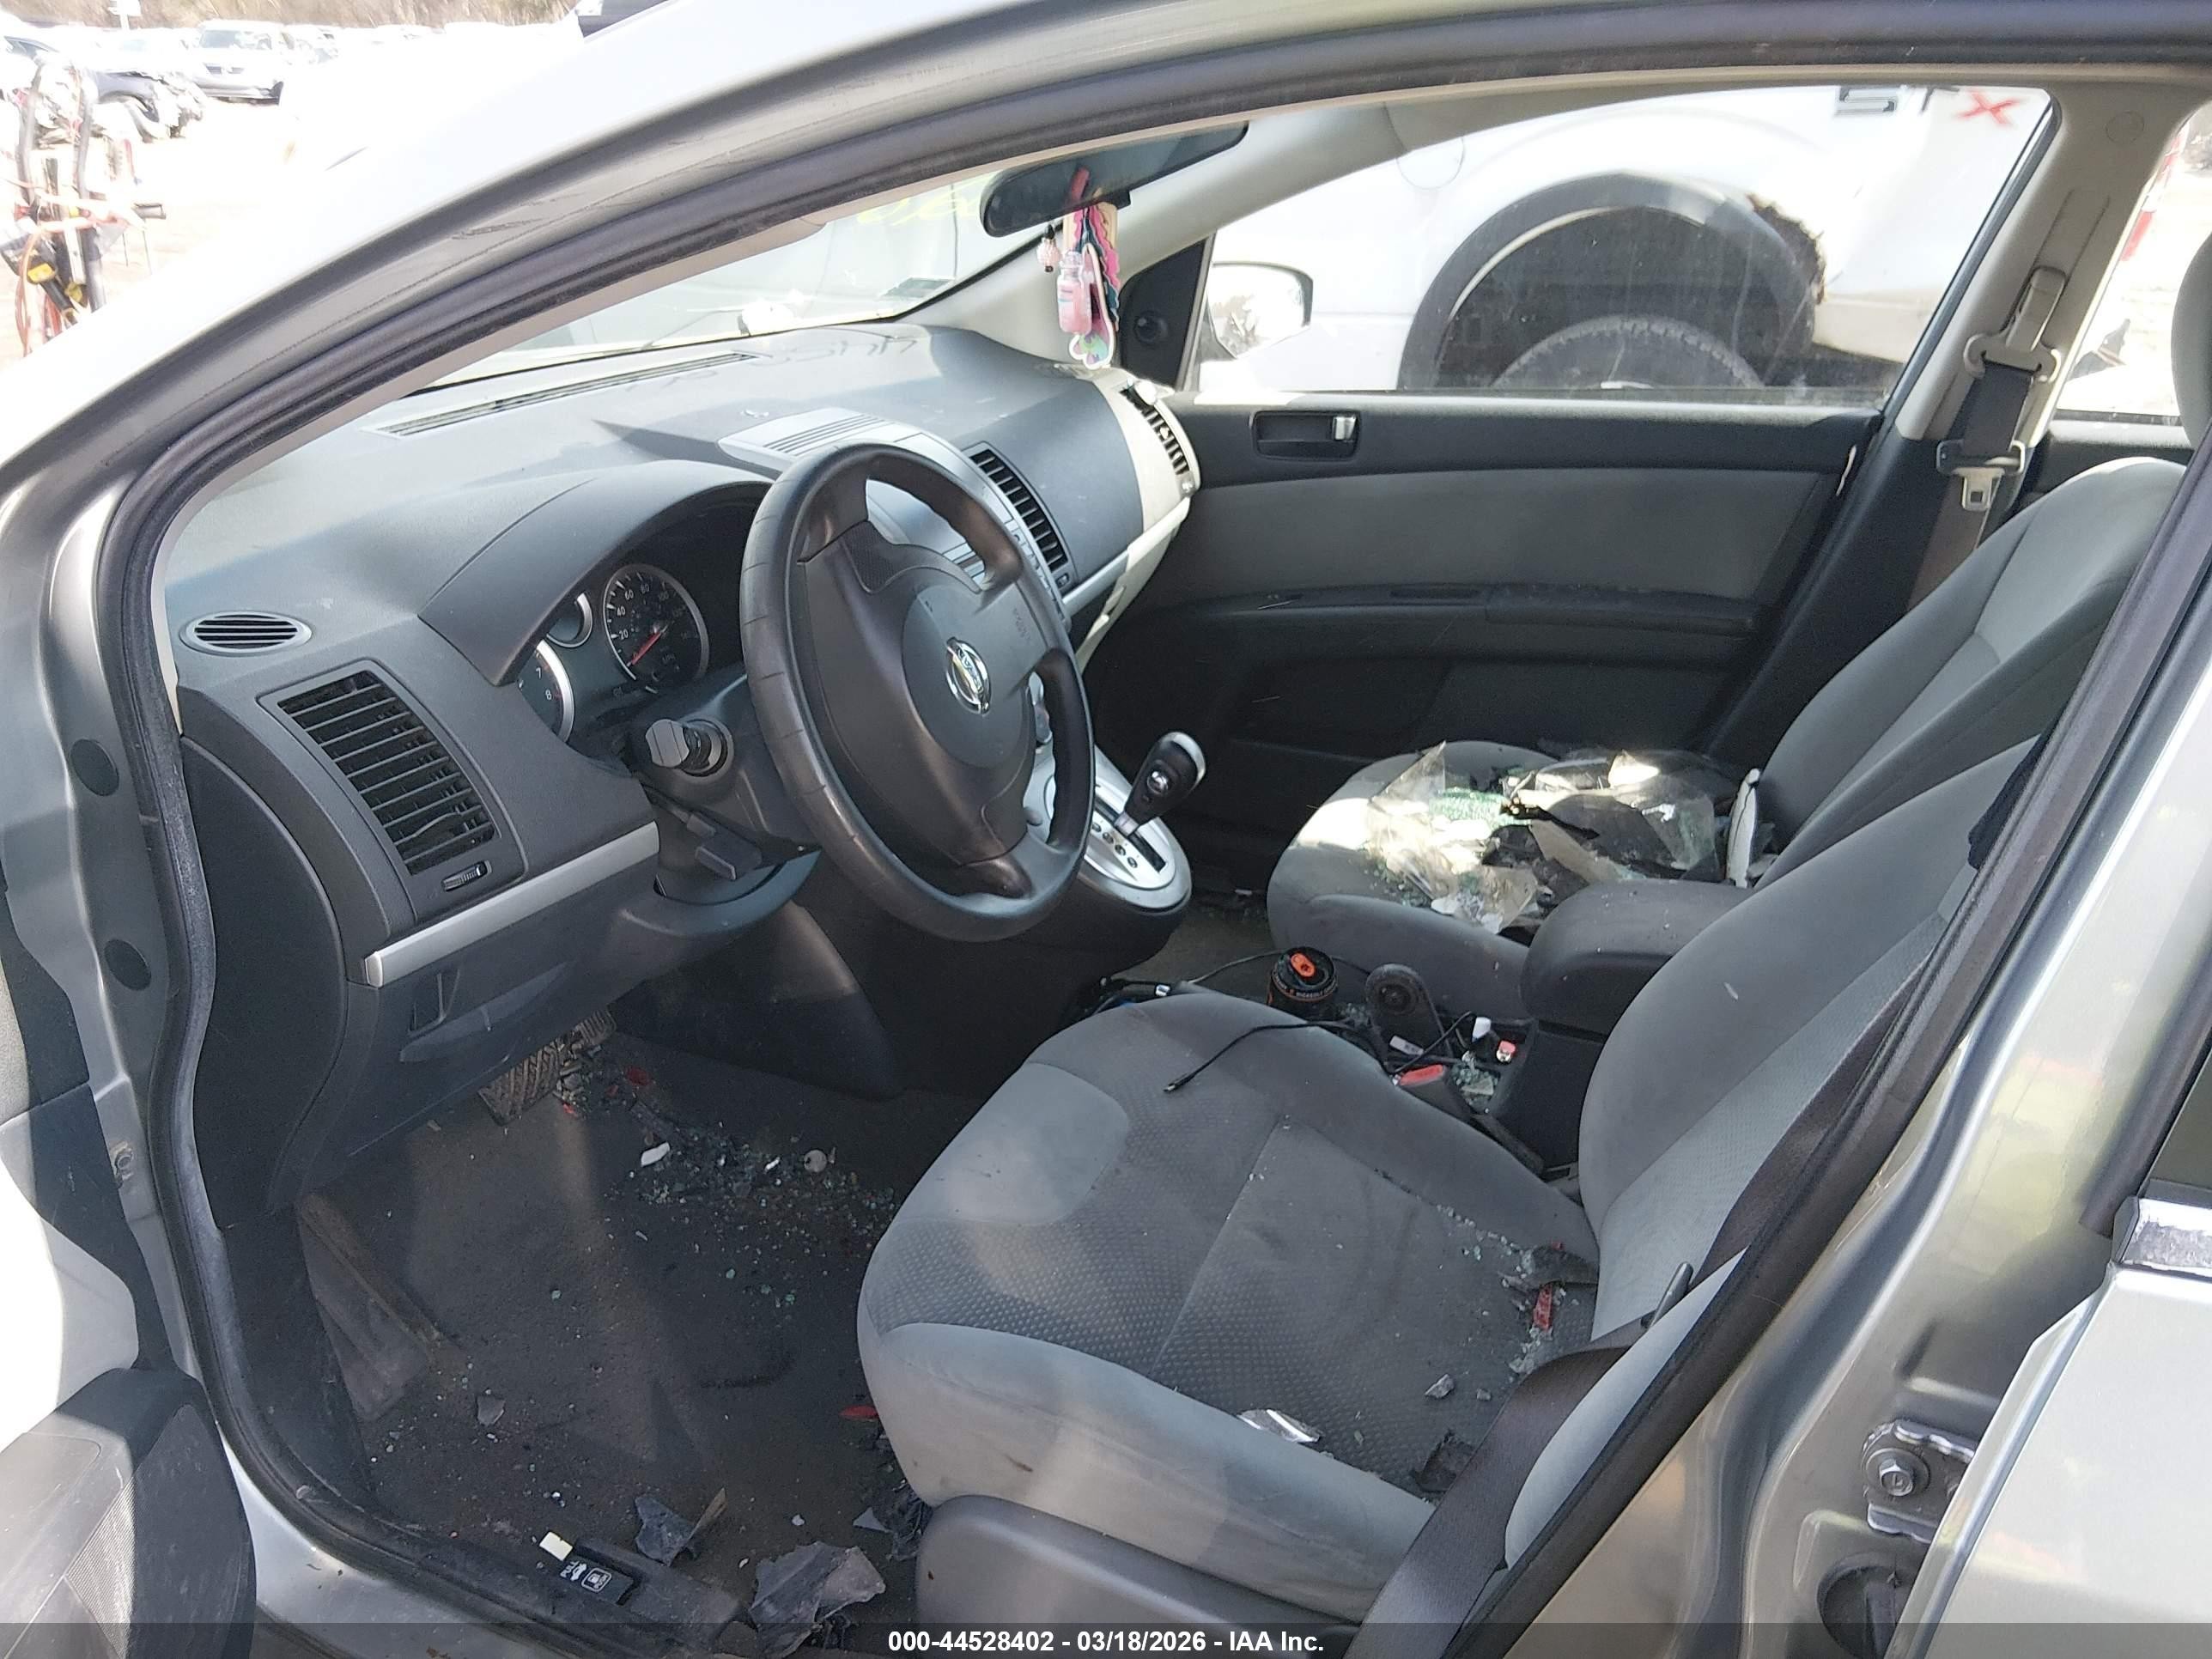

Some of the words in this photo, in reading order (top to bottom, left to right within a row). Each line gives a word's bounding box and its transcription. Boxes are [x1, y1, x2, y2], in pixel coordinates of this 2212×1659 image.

[624, 590, 635, 601] 60
[617, 605, 626, 617] 40
[618, 629, 629, 641] 20
[535, 667, 542, 678] 7
[544, 688, 552, 701] 8
[559, 1559, 580, 1578] PULL
